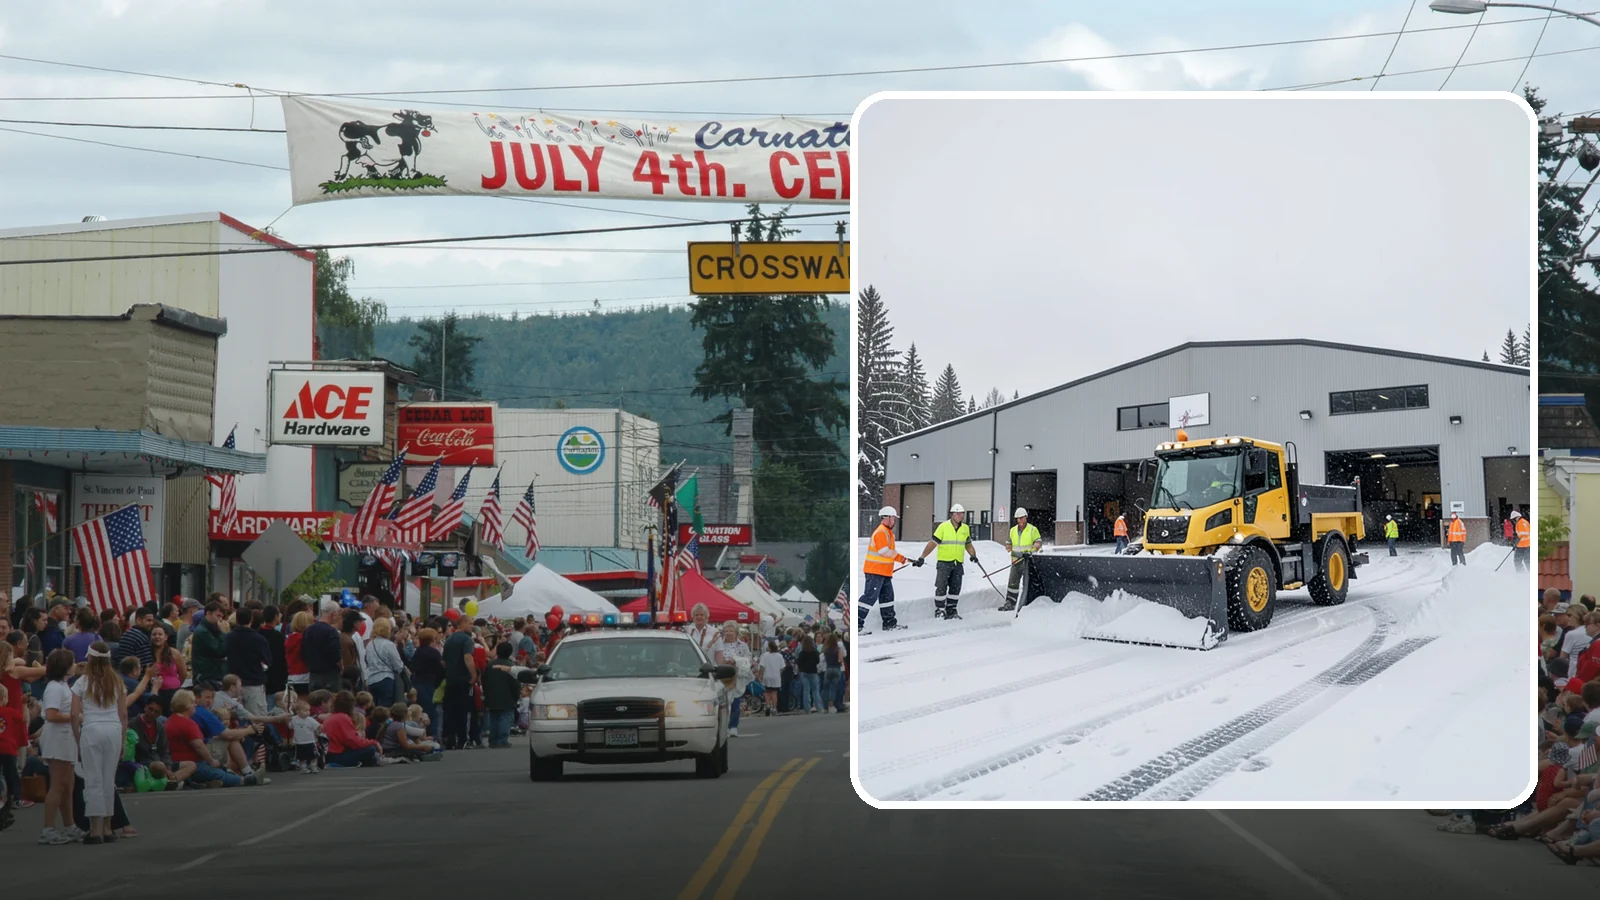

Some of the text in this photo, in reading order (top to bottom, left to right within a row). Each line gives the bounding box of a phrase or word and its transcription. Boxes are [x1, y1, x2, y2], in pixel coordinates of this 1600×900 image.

[481, 141, 605, 192] JULY
[633, 150, 746, 197] 4th.
[697, 254, 850, 280] CROSSWA
[283, 380, 373, 420] ACE
[406, 409, 485, 422] CEDAR LOG
[284, 421, 371, 436] Hardware
[417, 428, 477, 447] Coca-Cola
[83, 485, 155, 496] St. Vincent de Paul
[688, 526, 742, 536] CRNATION
[699, 535, 731, 544] GLASS
